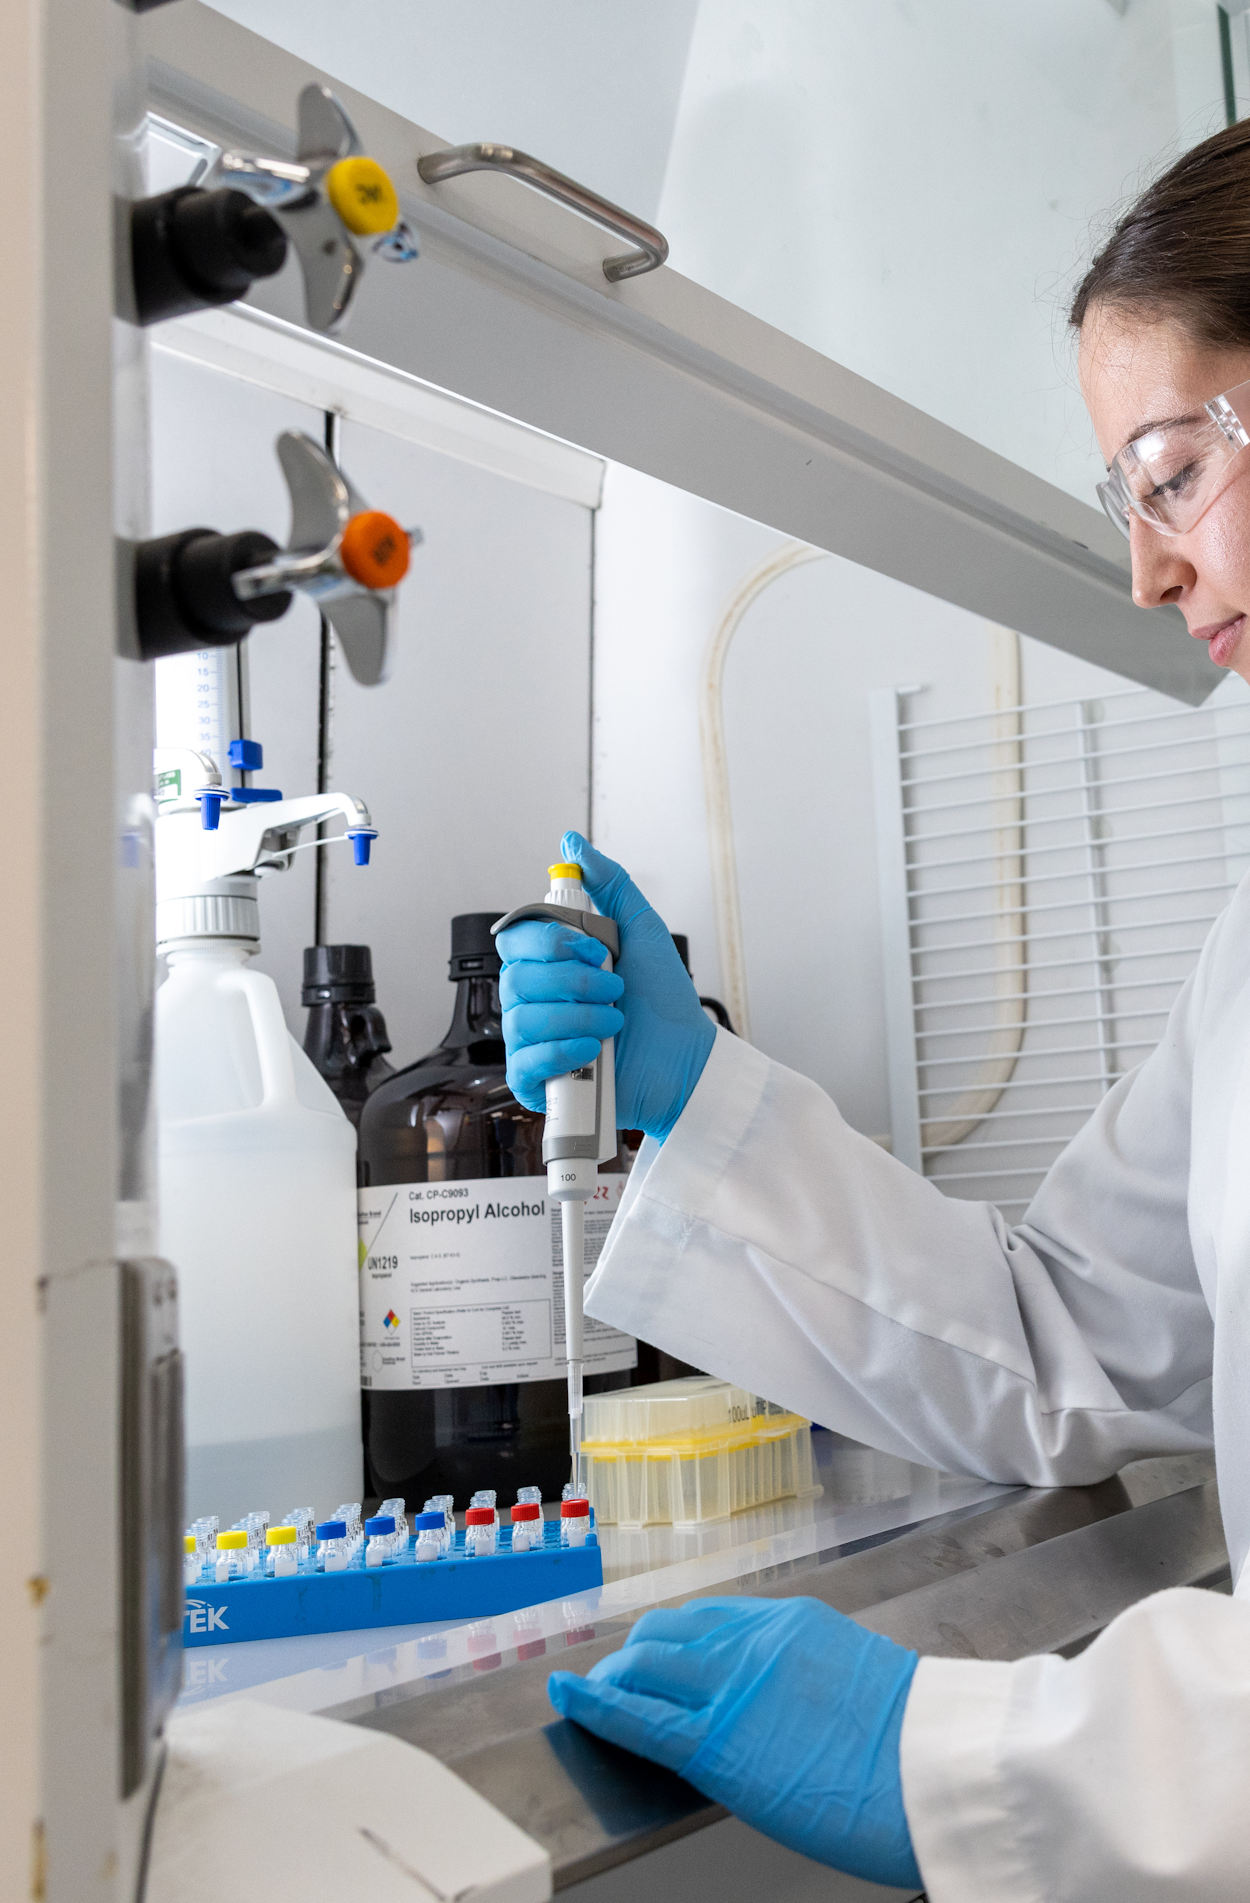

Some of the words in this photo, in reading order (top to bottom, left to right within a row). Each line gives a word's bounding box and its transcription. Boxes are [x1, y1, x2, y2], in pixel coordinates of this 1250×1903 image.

[197, 651, 209, 660] 10
[198, 668, 210, 677] 15
[197, 684, 210, 693] 20
[198, 700, 210, 709] 25
[198, 716, 211, 725] 30
[199, 732, 211, 741] 35
[560, 1173, 577, 1182] 100
[408, 1191, 424, 1201] Cat.
[426, 1188, 469, 1200] CP-C9093
[410, 1204, 479, 1226] Isopropyl
[484, 1200, 545, 1219] Alcohol
[367, 1255, 398, 1270] UN1219
